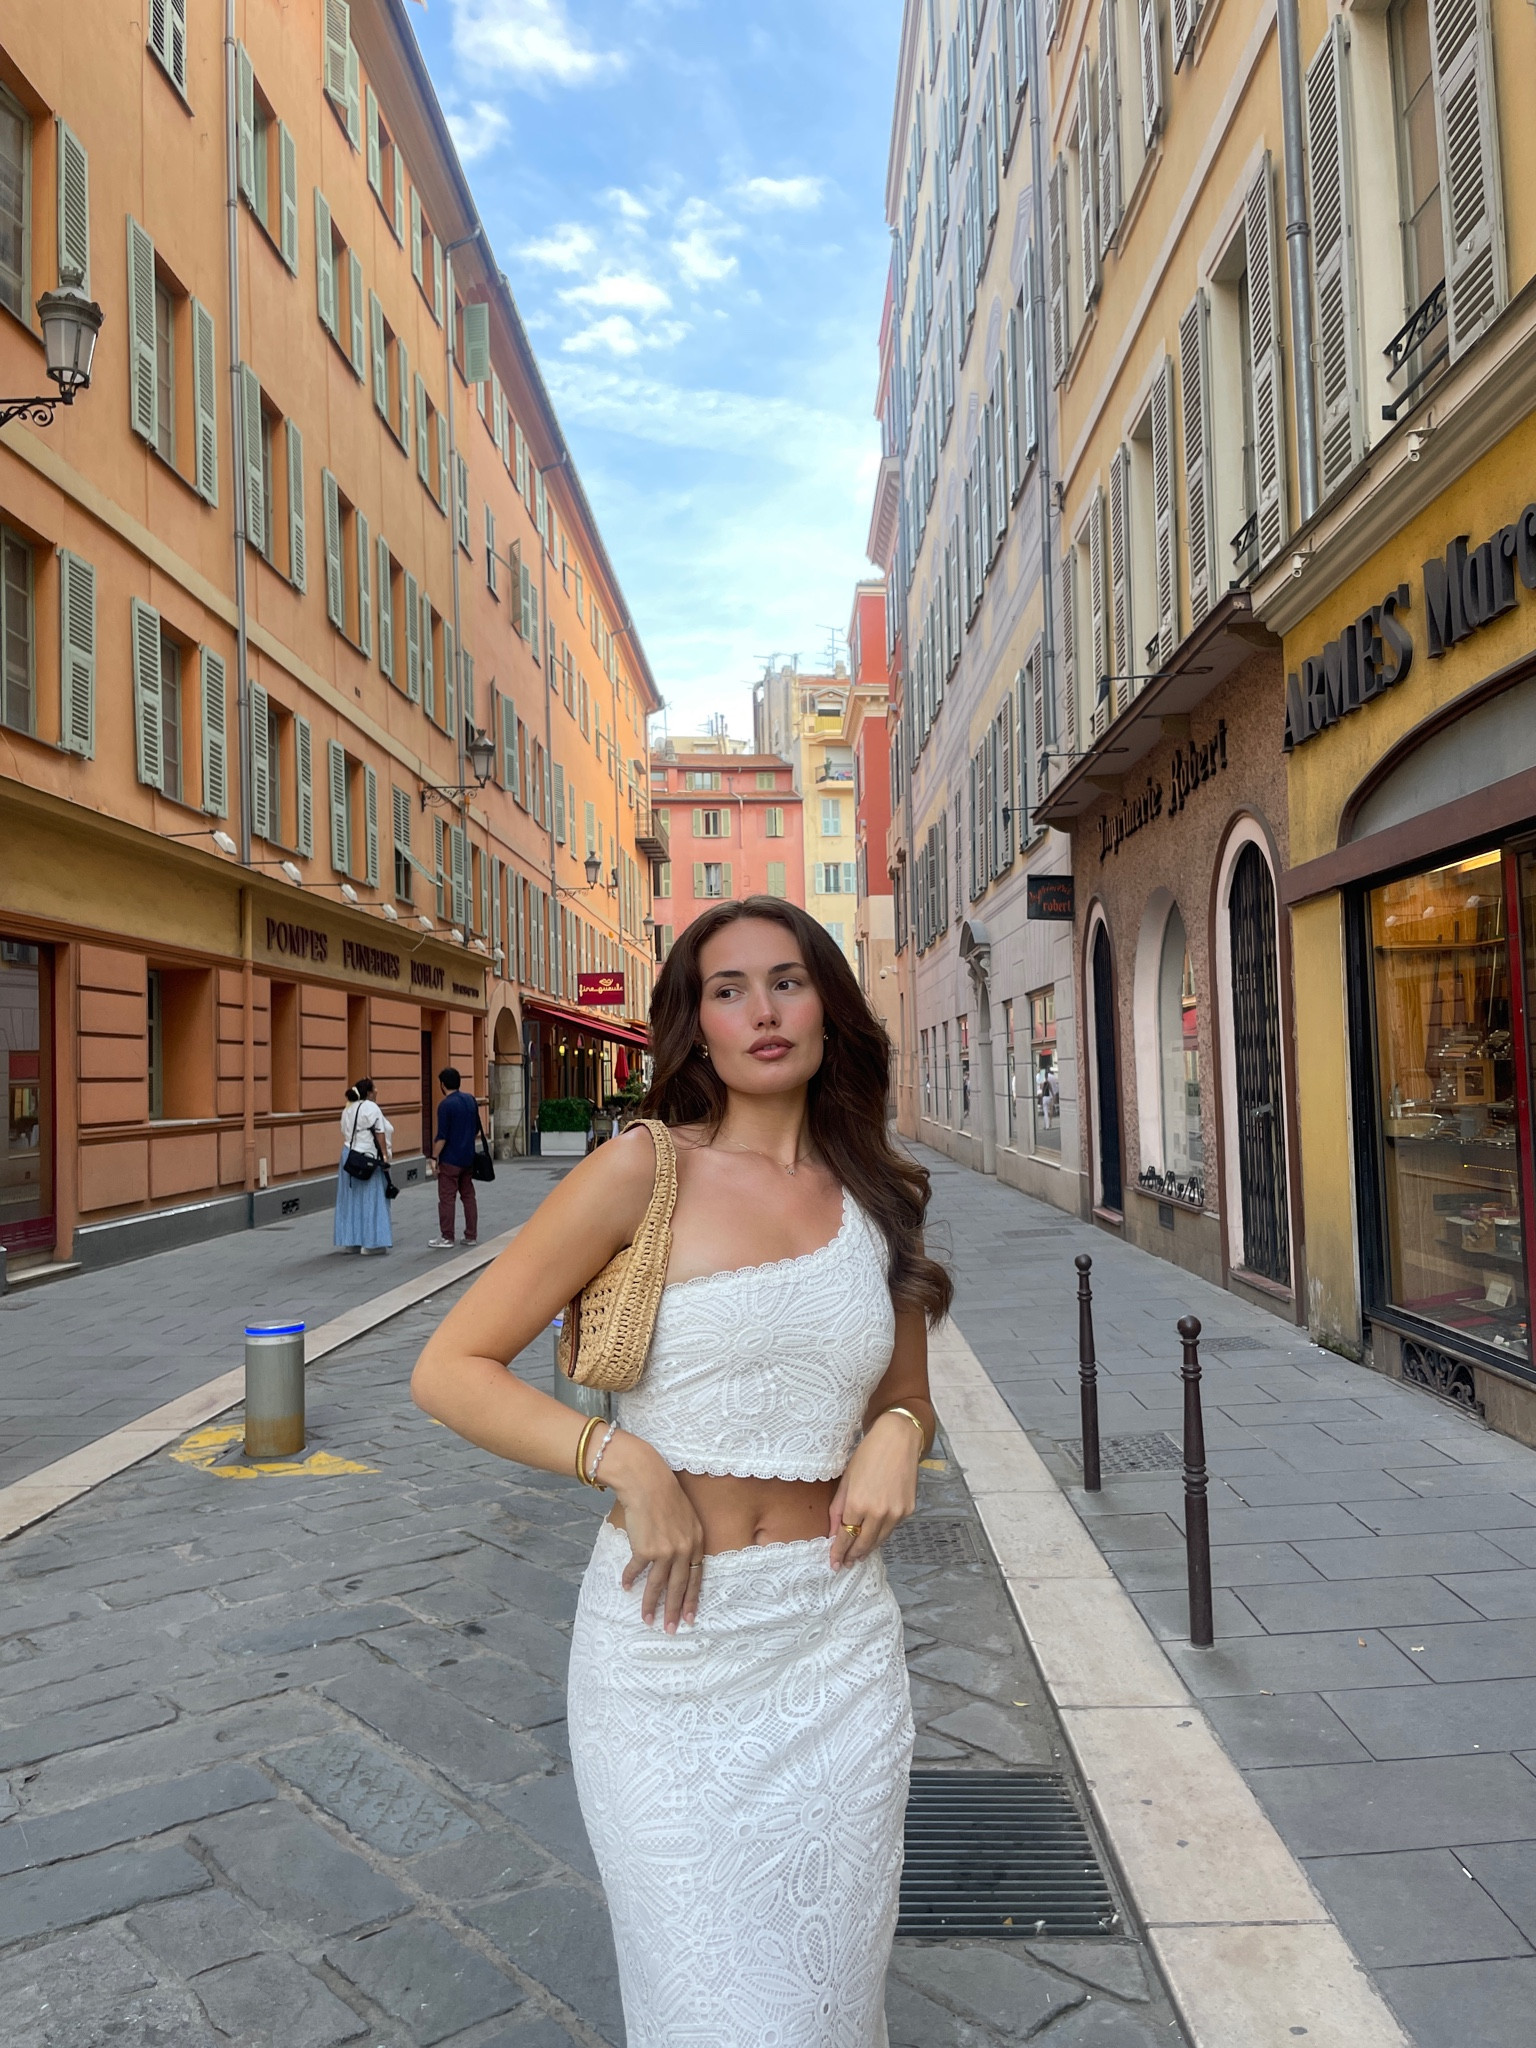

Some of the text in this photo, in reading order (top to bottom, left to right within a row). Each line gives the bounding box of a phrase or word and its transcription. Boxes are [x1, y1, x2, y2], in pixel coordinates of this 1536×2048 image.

[1282, 583, 1412, 753] ARMES
[1168, 718, 1227, 818] Robert
[266, 917, 328, 962] POMPES
[410, 959, 445, 991] ROBLOT
